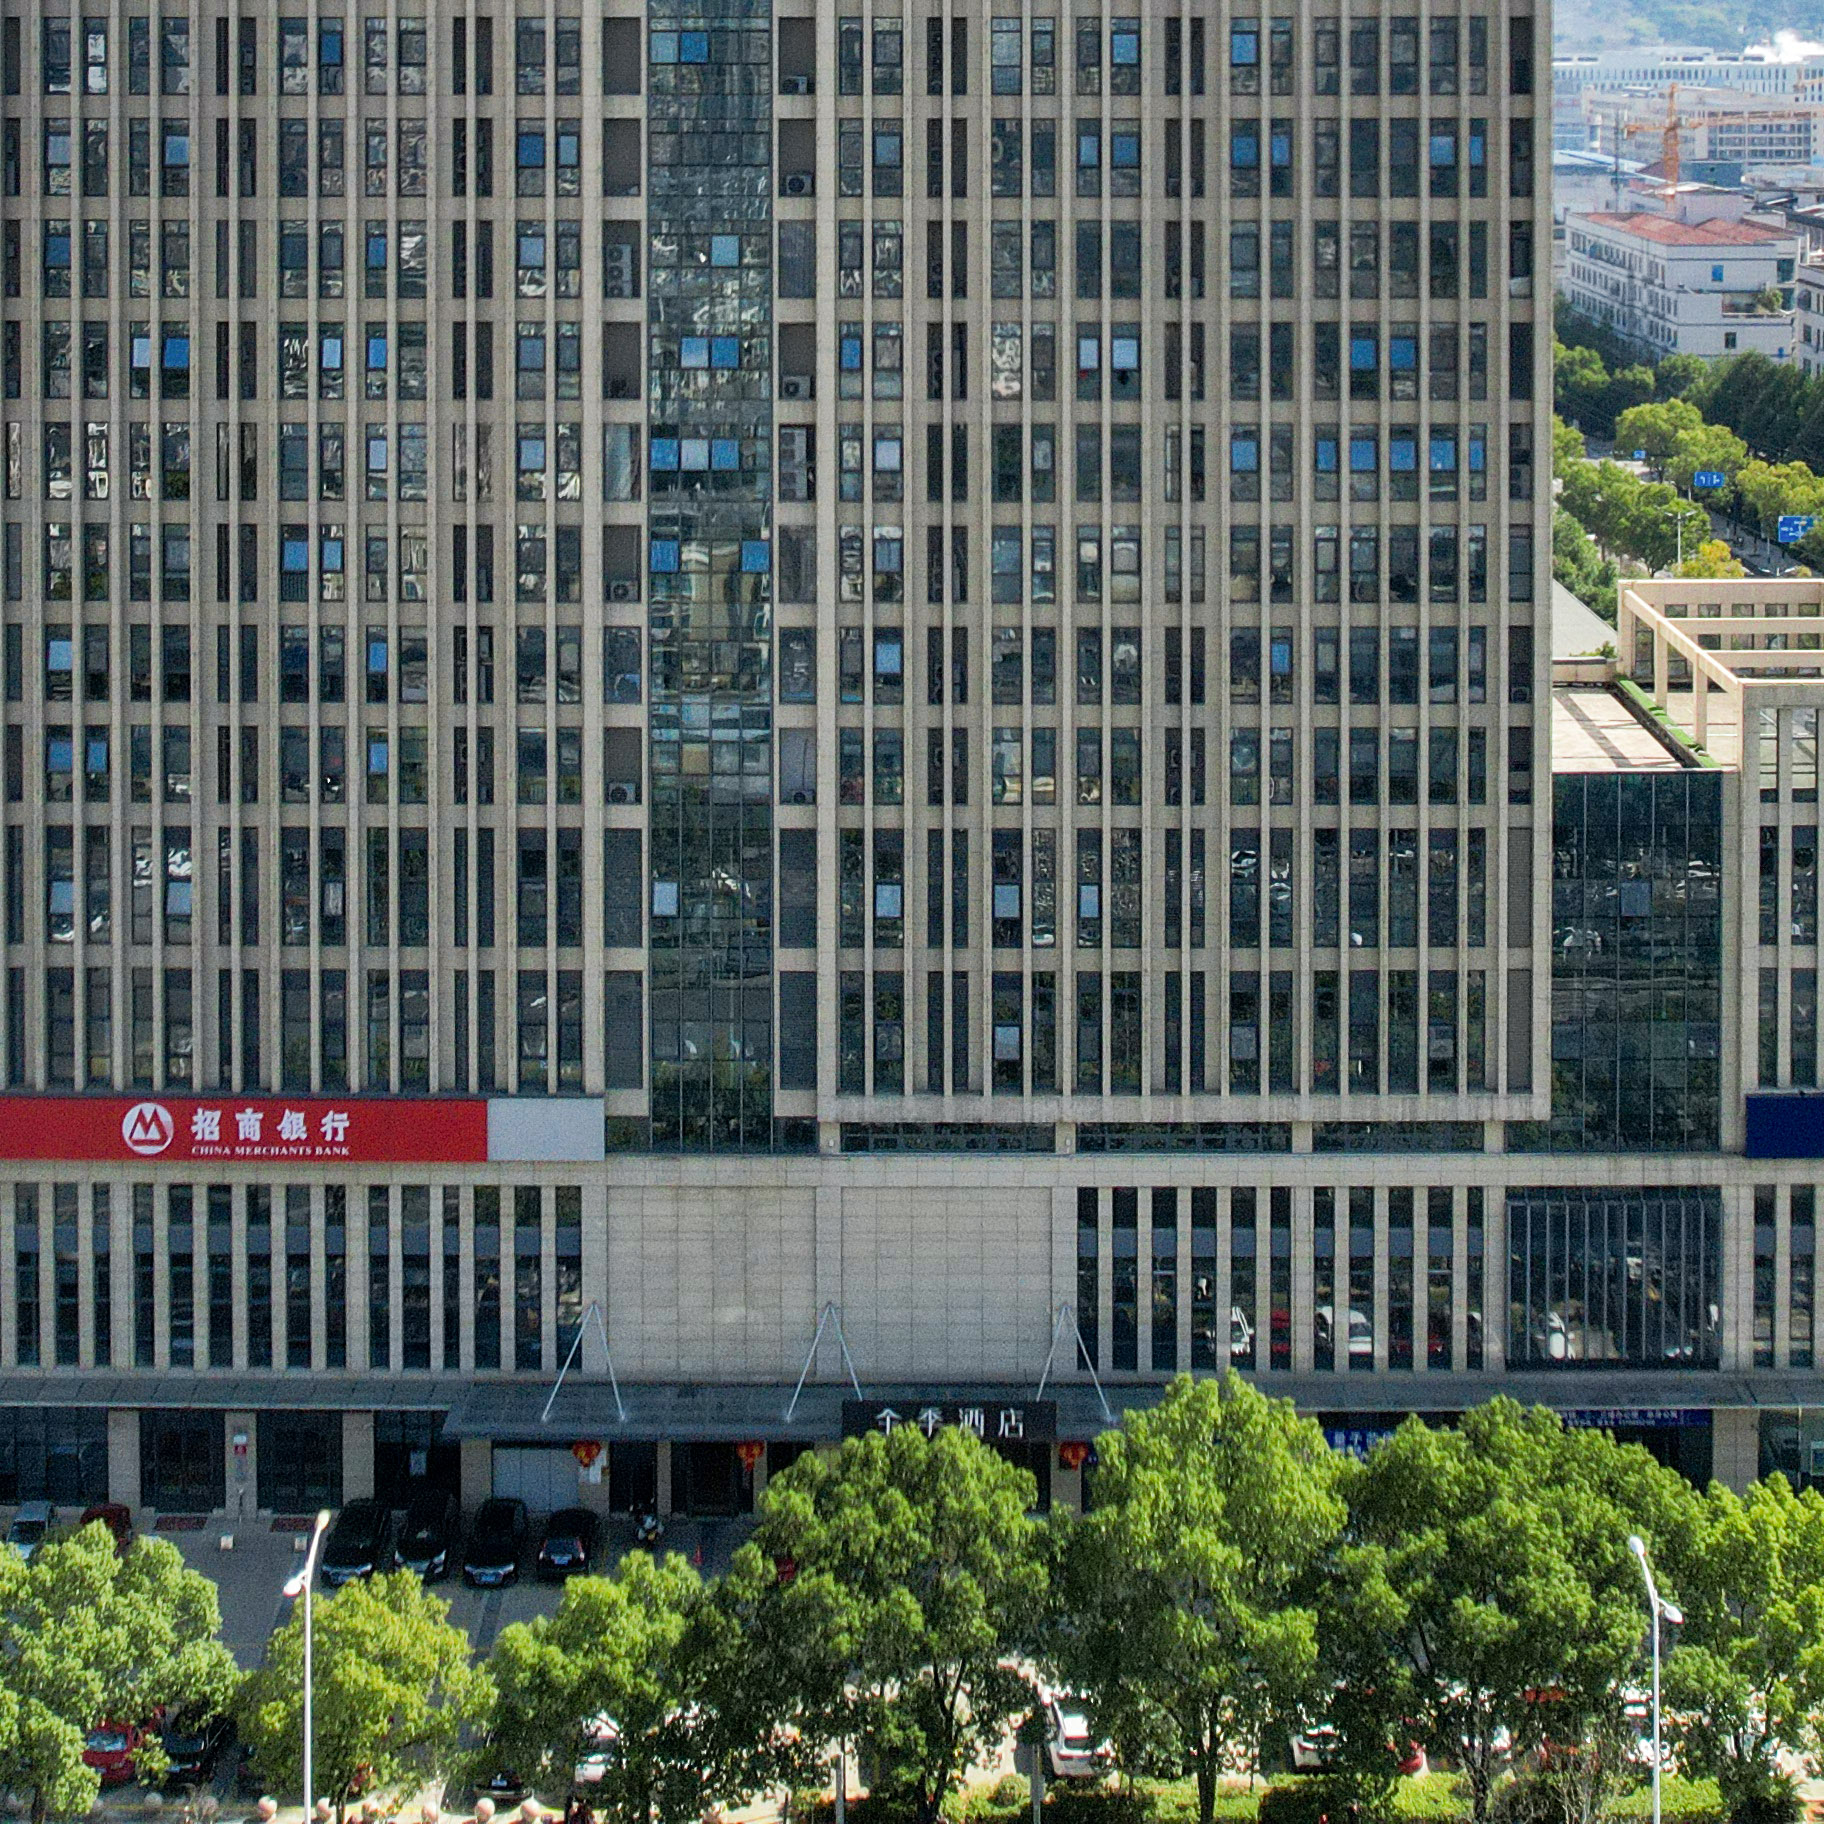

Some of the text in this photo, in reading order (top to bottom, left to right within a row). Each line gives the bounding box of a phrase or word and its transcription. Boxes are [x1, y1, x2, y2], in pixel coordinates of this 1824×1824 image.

[191, 1145, 350, 1156] CHINA MERCHANTS BANK
